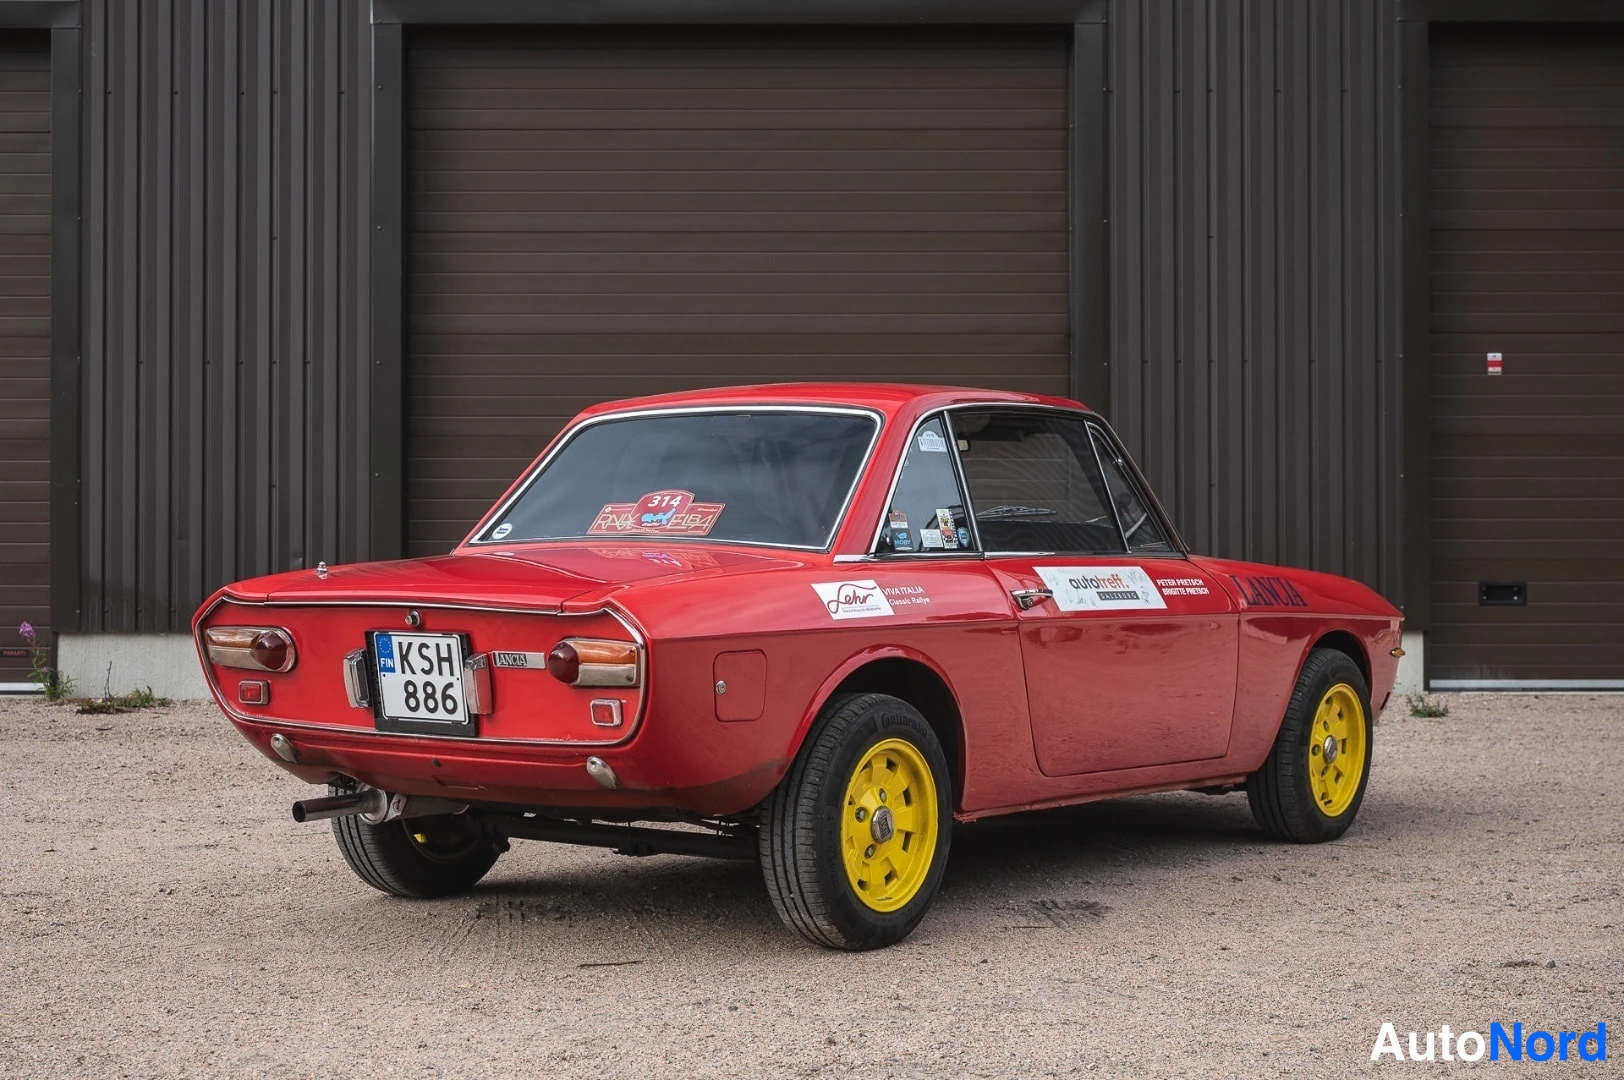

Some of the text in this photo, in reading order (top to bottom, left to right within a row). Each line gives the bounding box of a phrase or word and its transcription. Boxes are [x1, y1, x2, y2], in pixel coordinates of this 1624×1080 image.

[647, 495, 683, 508] 314
[666, 513, 715, 530] ELBA
[1156, 578, 1205, 587] PETER PRETSCH
[882, 586, 925, 596] VIVA ITALIA
[1099, 592, 1138, 600] SALZBURG
[1162, 587, 1210, 596] BRIGITTE PRETSCH
[1229, 575, 1309, 607] LANCIA
[889, 597, 931, 606] Classic Rallye
[380, 657, 395, 669] FIN
[398, 642, 455, 677] KSH
[494, 652, 528, 667] LANCIA
[403, 679, 458, 715] 886
